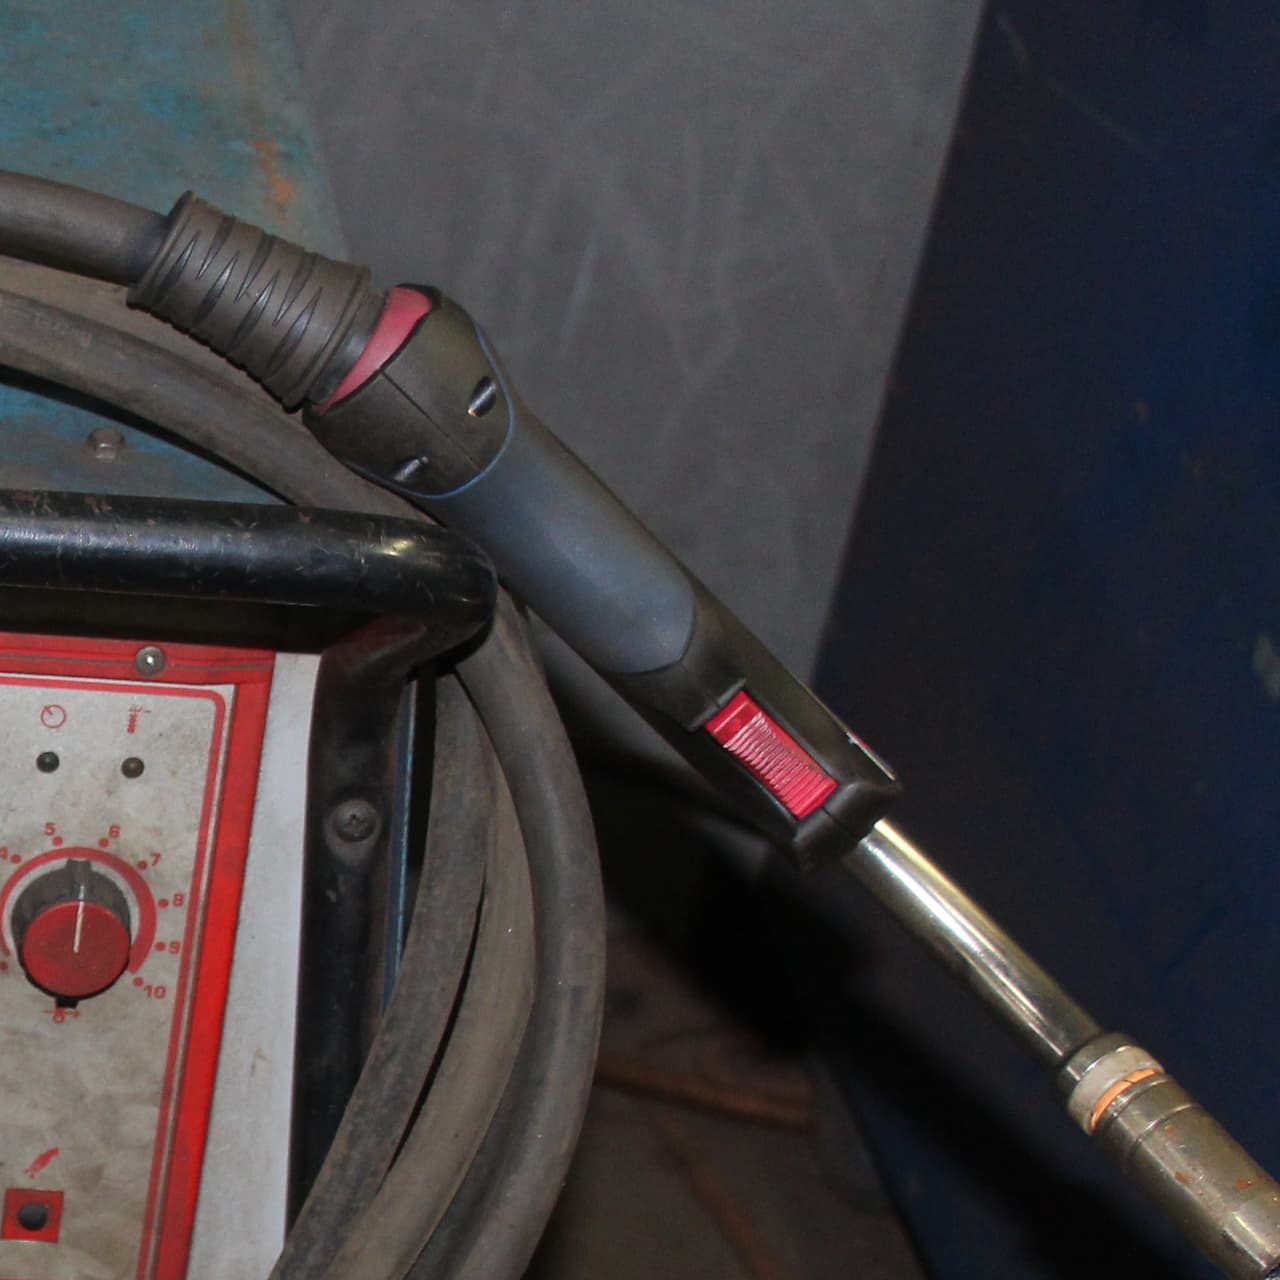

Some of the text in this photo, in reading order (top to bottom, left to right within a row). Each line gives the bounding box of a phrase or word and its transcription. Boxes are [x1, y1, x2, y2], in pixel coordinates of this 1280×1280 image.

[43, 822, 56, 836] 5
[107, 824, 122, 839] 6
[149, 852, 161, 867] 7
[171, 892, 185, 907] 8
[167, 940, 182, 955] 9
[142, 982, 167, 1000] 10
